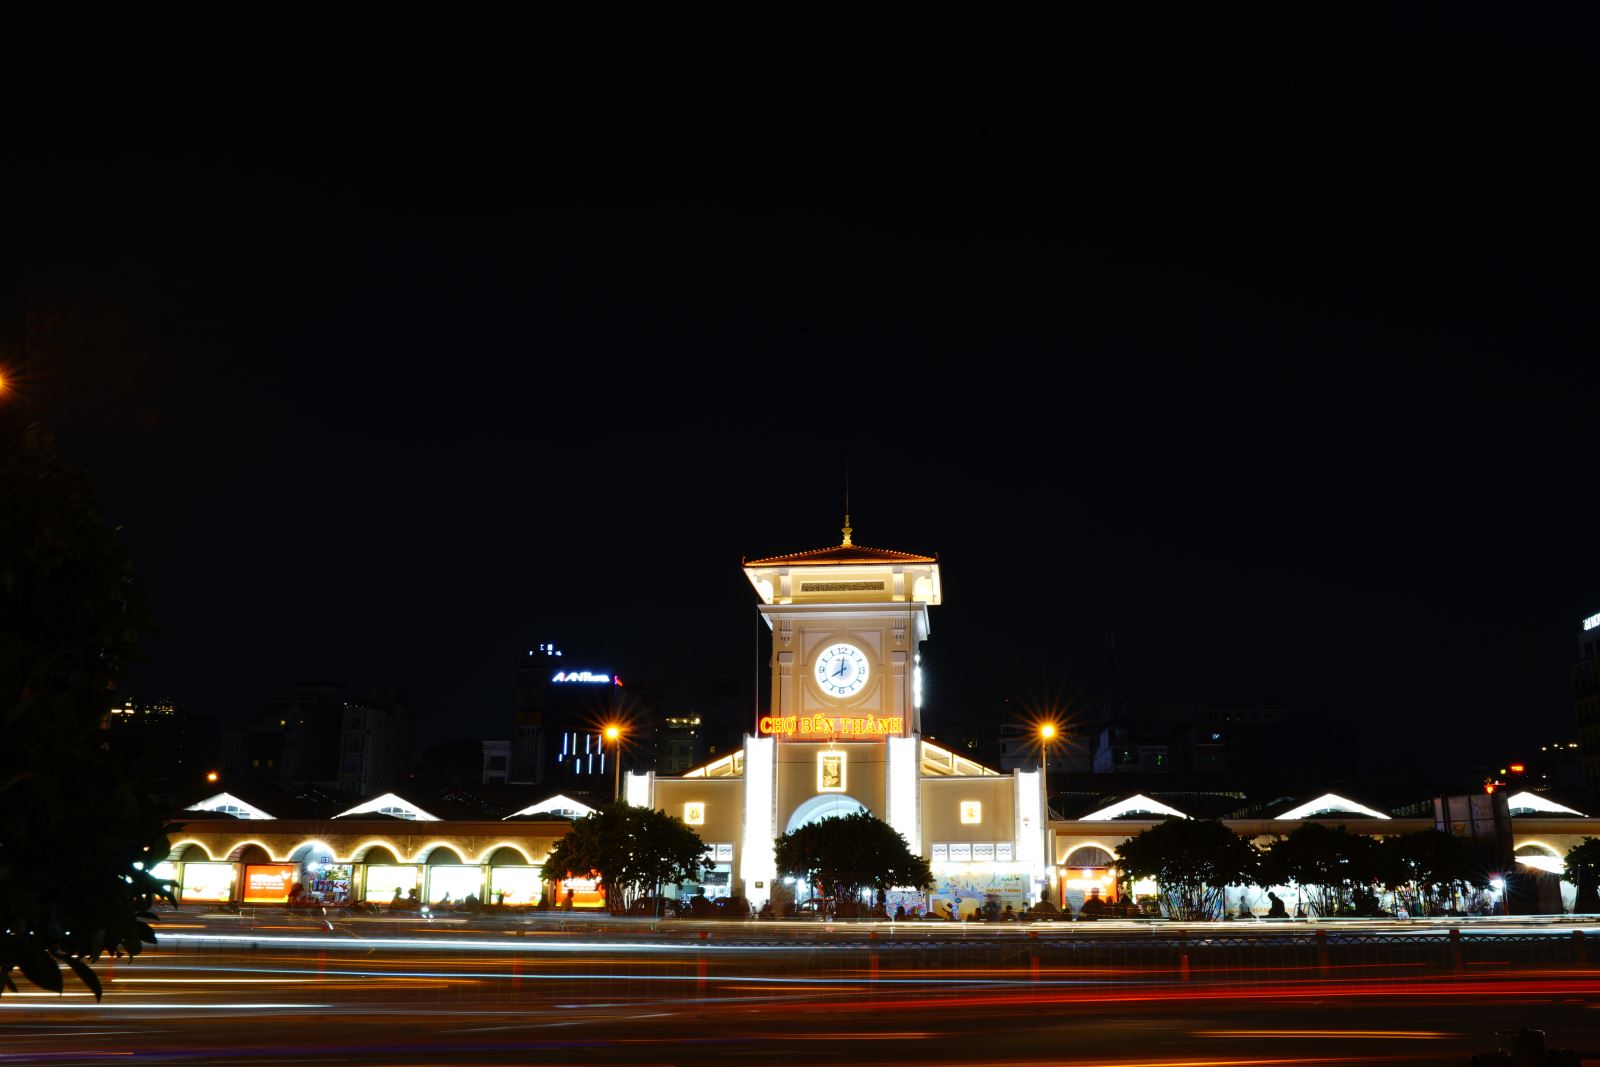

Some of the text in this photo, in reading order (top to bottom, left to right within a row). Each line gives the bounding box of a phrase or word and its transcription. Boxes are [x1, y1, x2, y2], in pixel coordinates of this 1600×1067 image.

[837, 647, 848, 655] 12
[838, 687, 845, 695] 6
[760, 716, 797, 736] CHỢ
